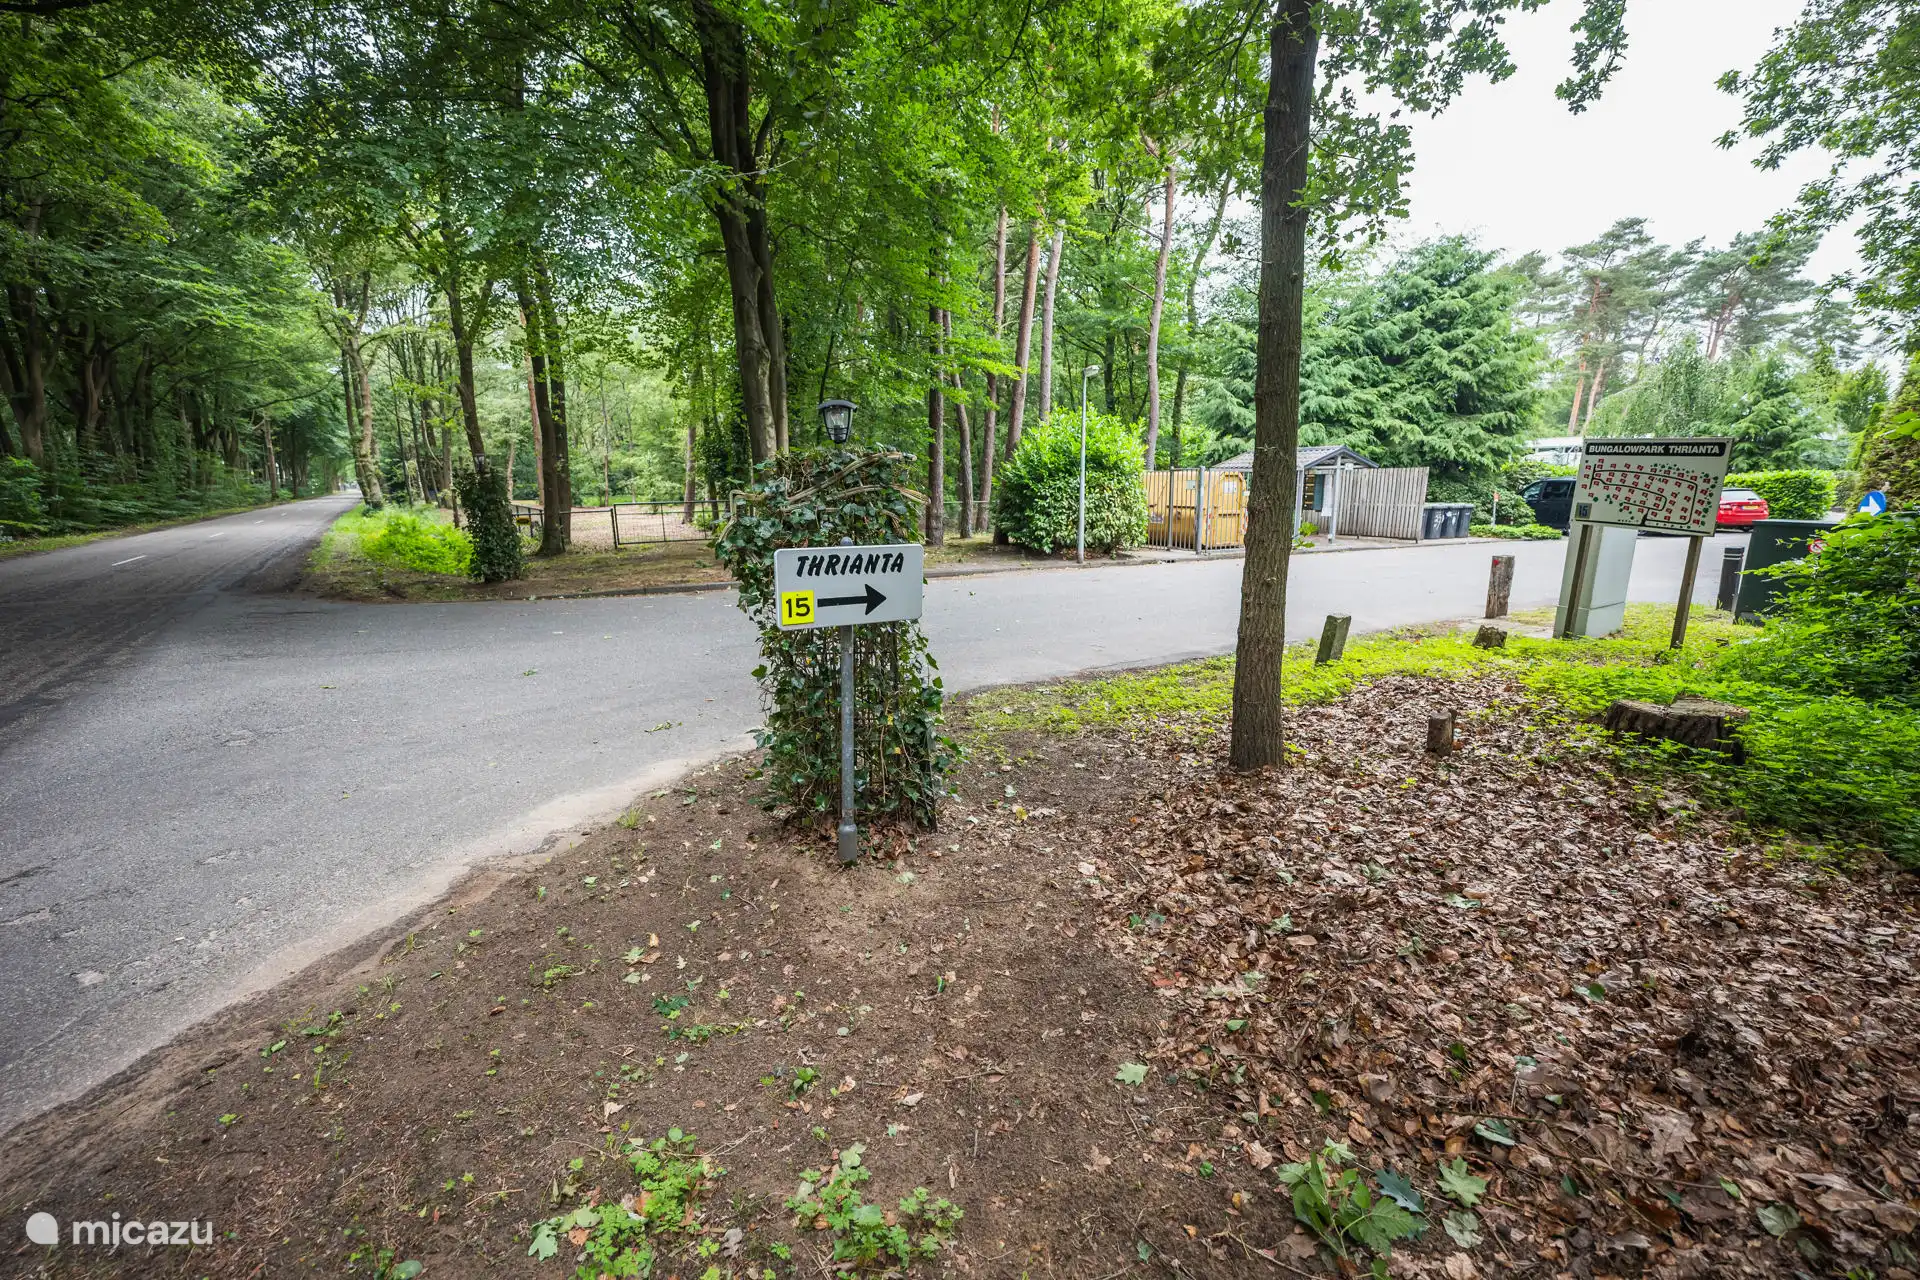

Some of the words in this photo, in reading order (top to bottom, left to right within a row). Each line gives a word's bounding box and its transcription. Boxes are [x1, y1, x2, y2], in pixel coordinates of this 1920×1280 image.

[1588, 445, 1665, 454] BUNGALOWPARK
[1668, 445, 1720, 454] THRIANTA
[796, 552, 904, 577] THRIANTA
[785, 597, 811, 618] 15
